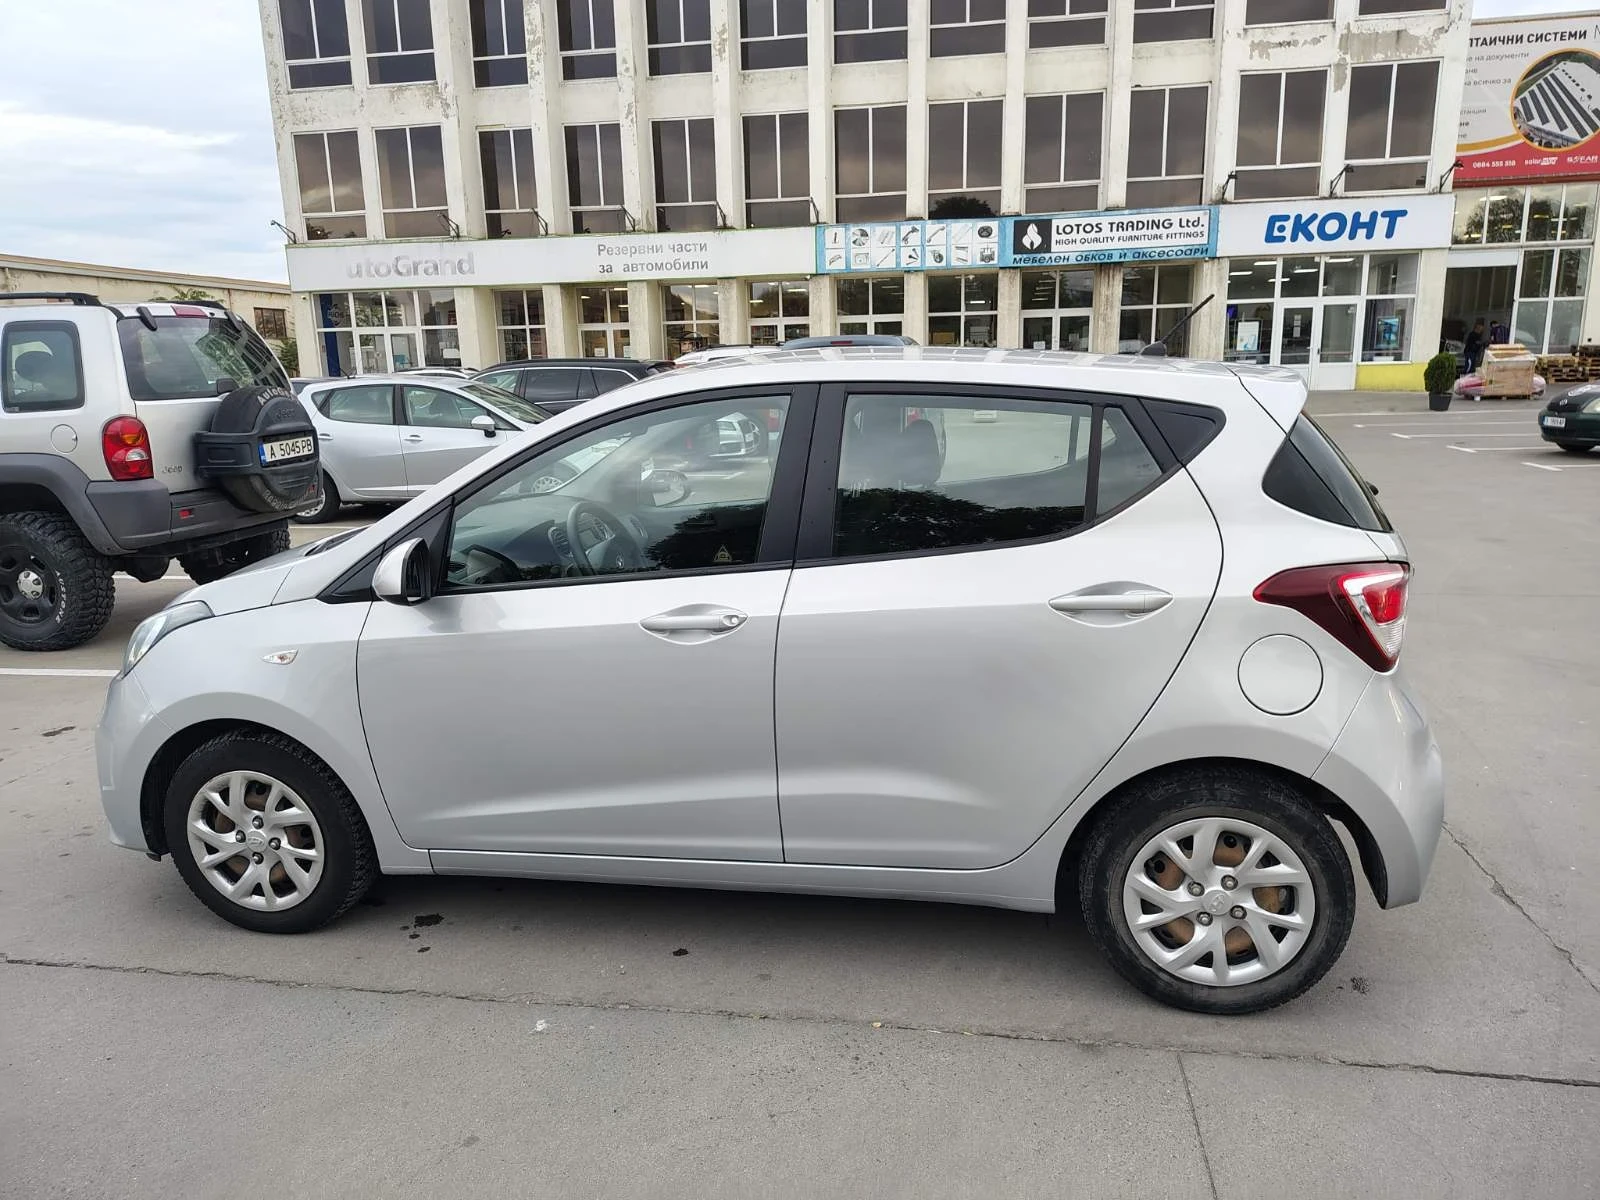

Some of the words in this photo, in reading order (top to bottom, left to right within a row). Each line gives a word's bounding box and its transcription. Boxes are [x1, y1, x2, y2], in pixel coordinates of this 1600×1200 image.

[1527, 30, 1588, 43] СИСТЕМИ
[1486, 52, 1529, 62] документи
[1056, 222, 1103, 236] LOTOS
[1108, 218, 1173, 232] TRADING
[1178, 216, 1205, 229] Ltd.
[1264, 209, 1408, 244] ЕКОНТ
[1055, 237, 1077, 246] HIGH
[1079, 235, 1115, 245] QUALITY
[1117, 232, 1164, 243] FURNITURE
[1165, 230, 1205, 240] FITTINGS
[597, 243, 664, 258] Резервни
[668, 242, 708, 254] части
[1132, 246, 1209, 260] аксесоари
[346, 252, 476, 279] utoGrand
[598, 263, 613, 274] за
[623, 258, 709, 273] автомобили
[270, 444, 276, 459] A
